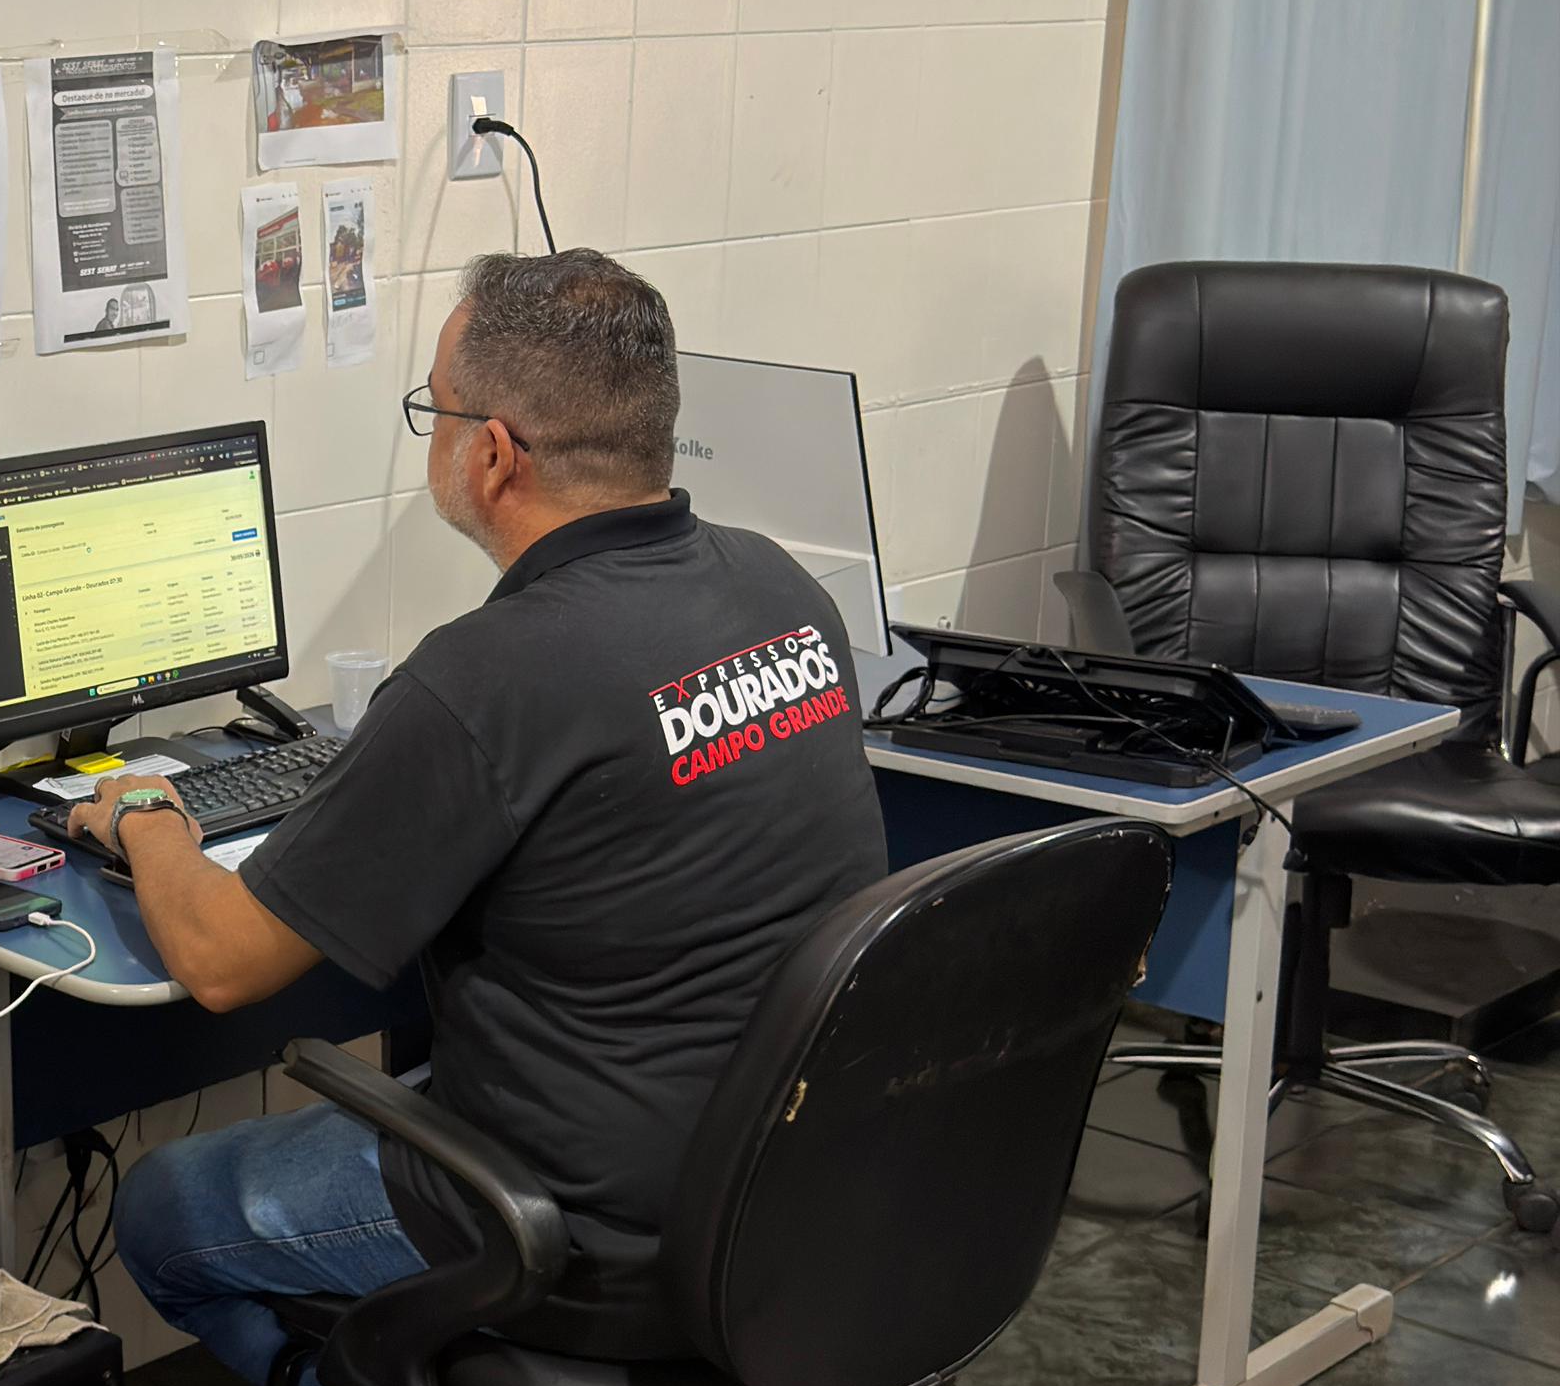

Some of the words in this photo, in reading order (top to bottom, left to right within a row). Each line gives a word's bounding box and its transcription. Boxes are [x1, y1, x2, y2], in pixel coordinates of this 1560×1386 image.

[21, 592, 36, 602] Linha
[45, 587, 64, 598] Campo
[63, 584, 82, 594] Grande
[85, 579, 109, 589] Dourados
[653, 636, 799, 713] EXPRESSO
[659, 643, 839, 755] DOURADOS
[671, 723, 766, 787] CAMPO
[769, 686, 851, 740] GRANDE
